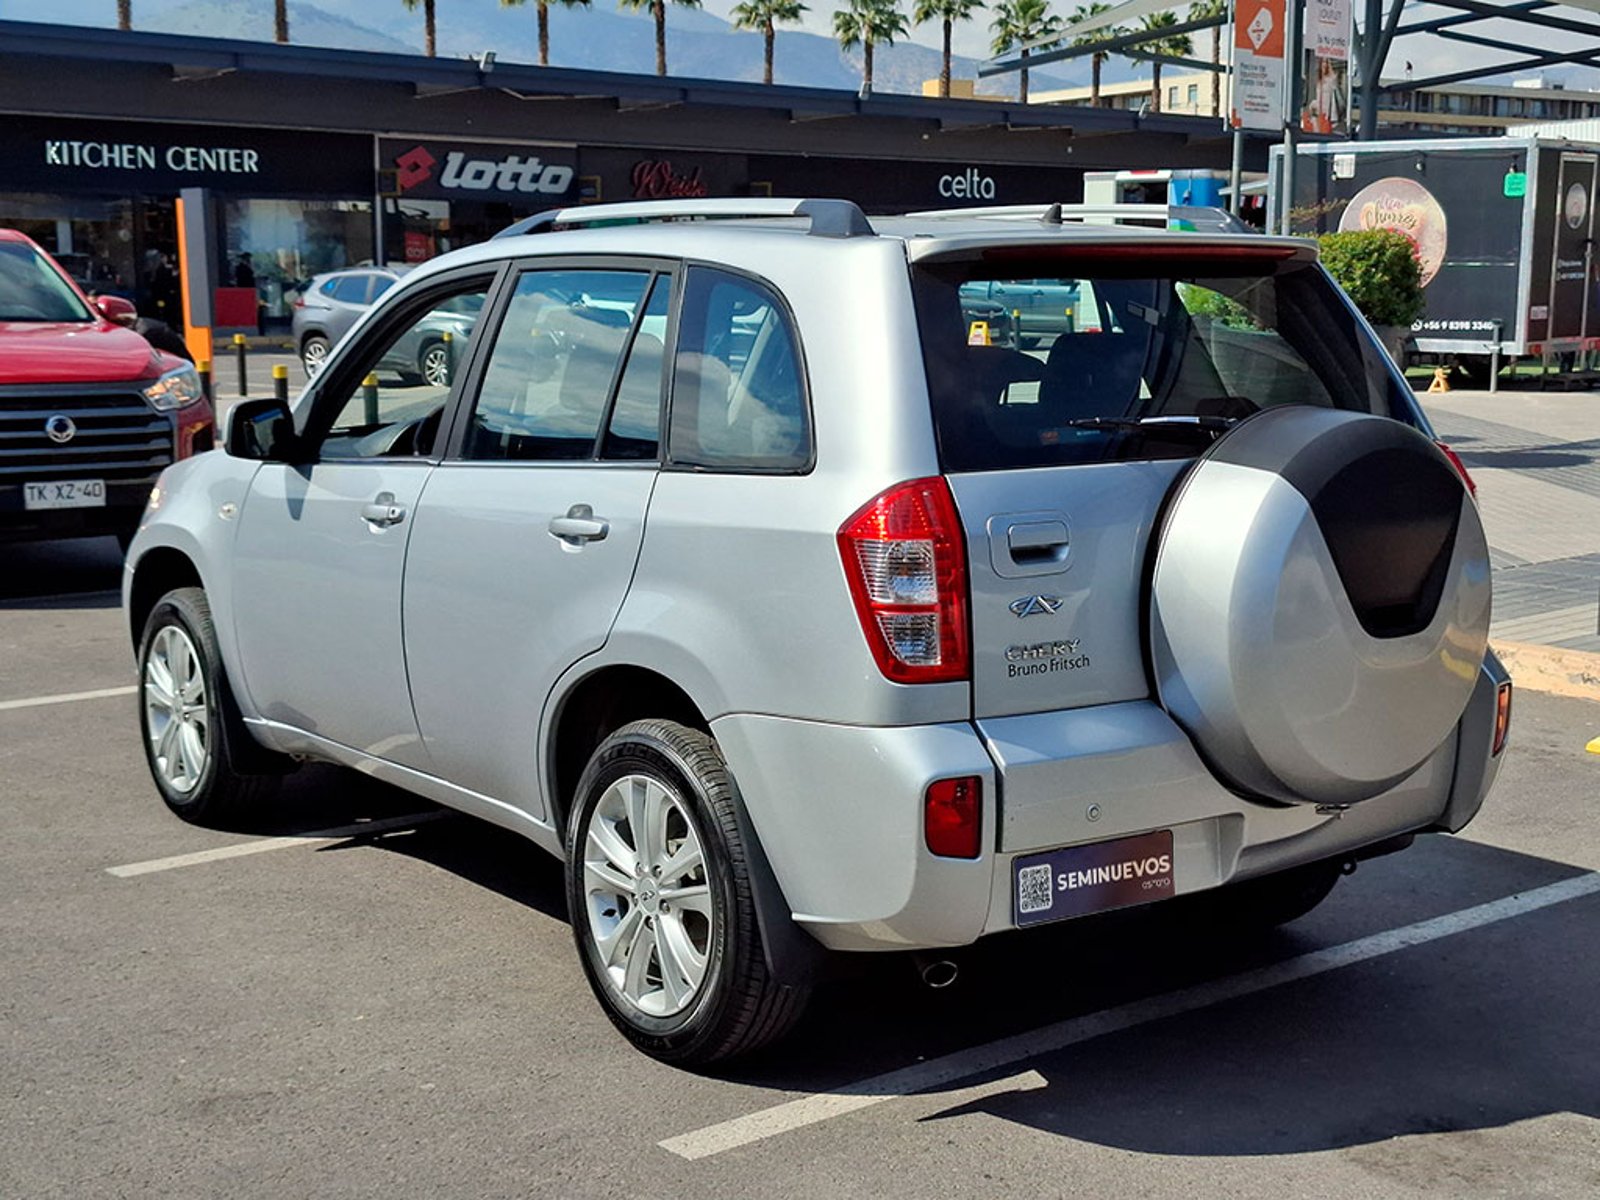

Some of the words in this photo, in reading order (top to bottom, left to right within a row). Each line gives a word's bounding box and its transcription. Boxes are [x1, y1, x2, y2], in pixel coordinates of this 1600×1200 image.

[45, 140, 156, 170] KITCHEN
[165, 146, 259, 173] CENTER
[439, 151, 574, 195] lotto
[938, 167, 995, 199] celta
[1005, 638, 1080, 662] CHERY
[1008, 663, 1048, 678] Bruno
[1050, 655, 1090, 672] Fritsch
[1056, 854, 1171, 892] SEMINUEVOS
